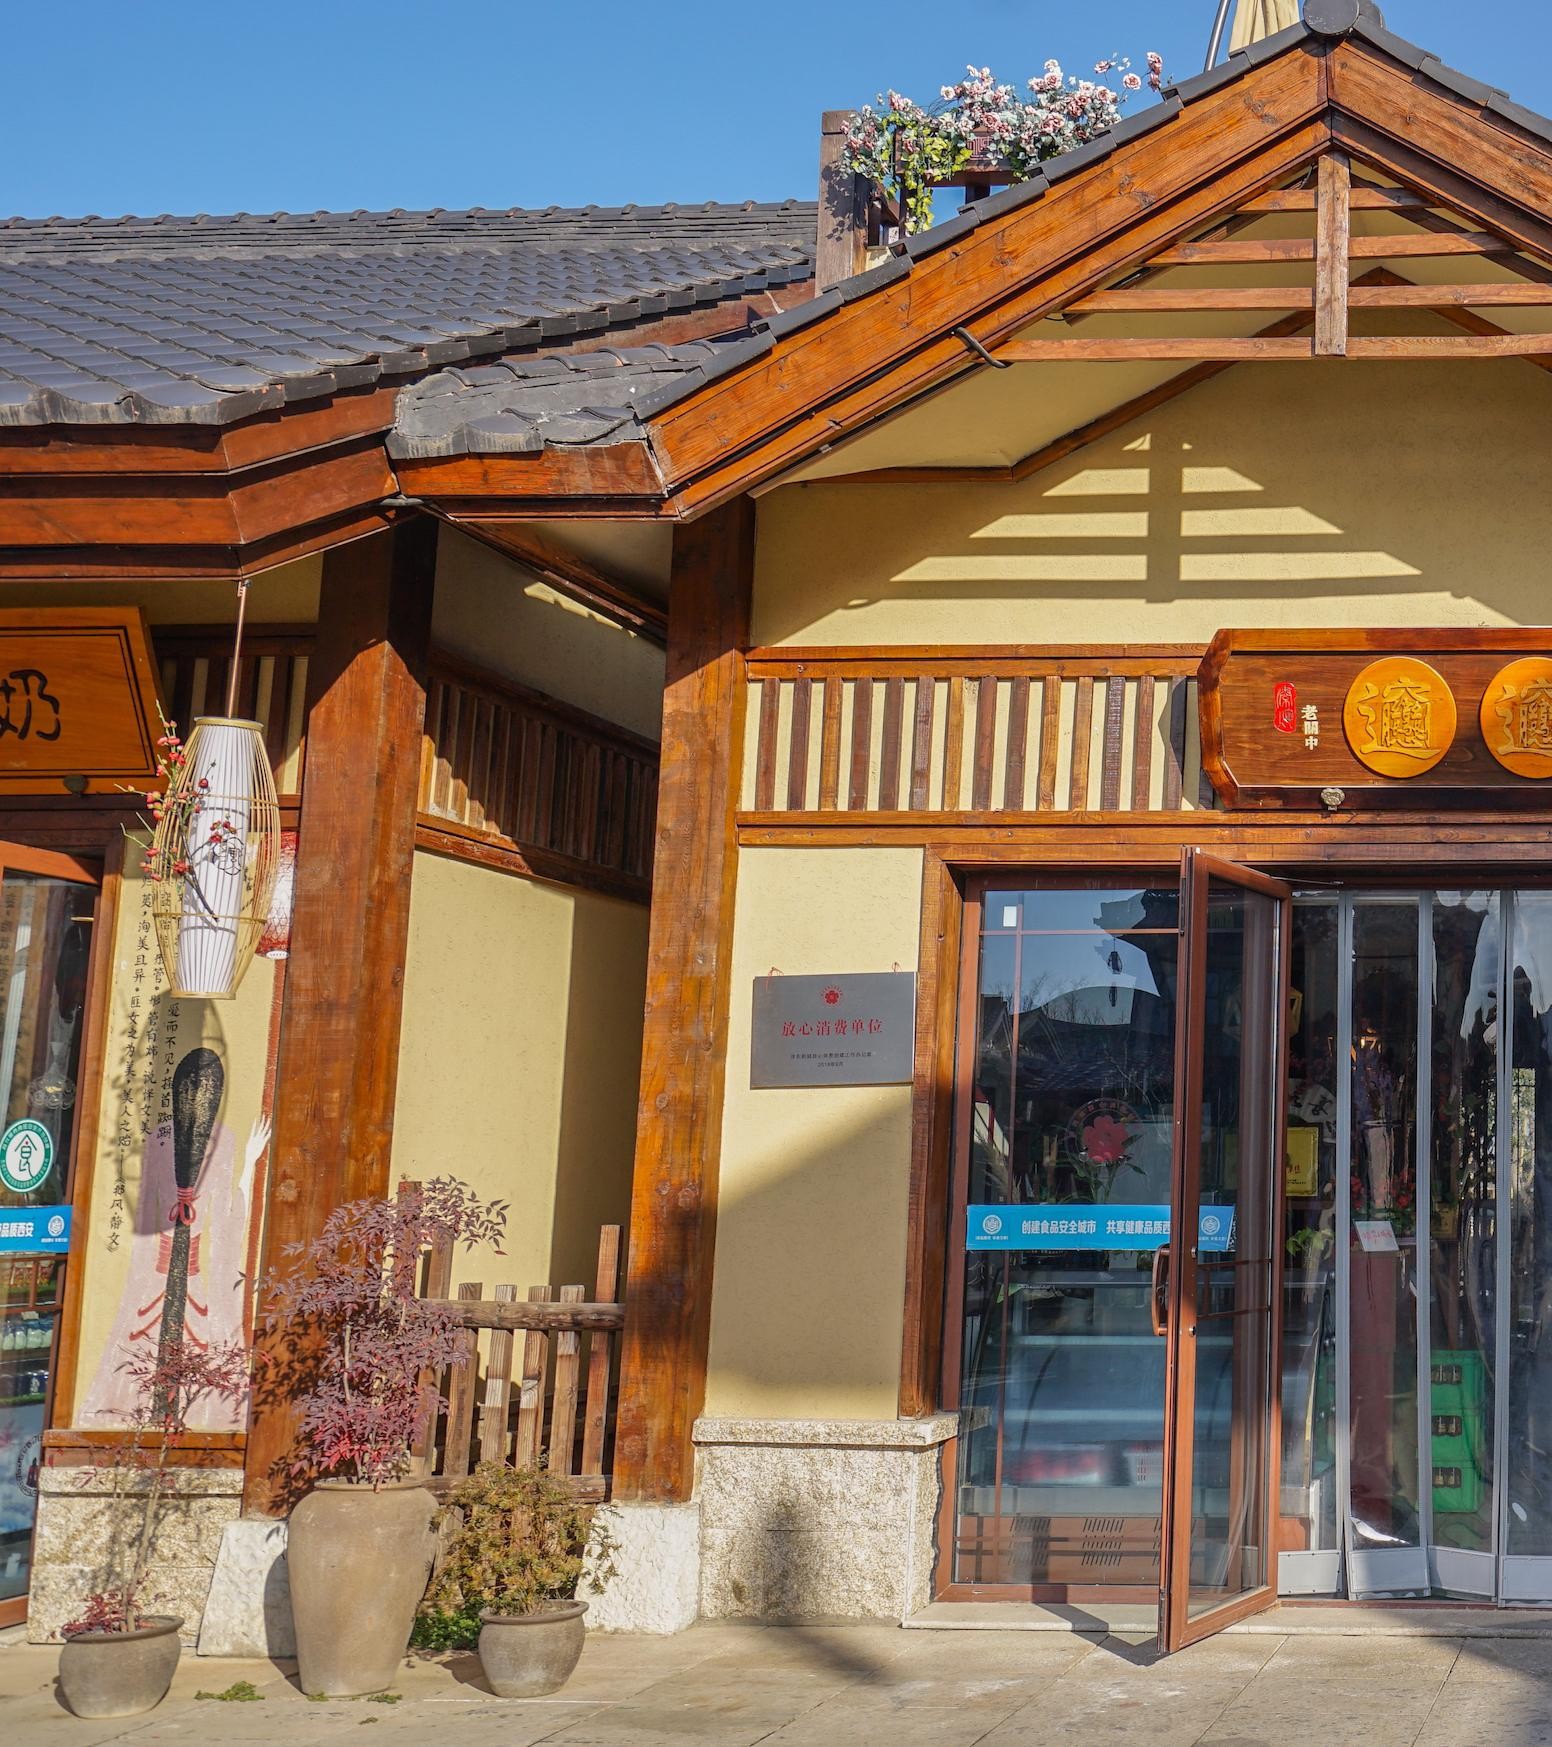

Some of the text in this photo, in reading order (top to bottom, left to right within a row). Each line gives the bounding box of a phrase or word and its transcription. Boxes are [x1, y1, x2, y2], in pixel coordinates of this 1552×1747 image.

[781, 1018, 884, 1037] 放心消费单位
[1021, 1219, 1097, 1234] 创建食品安全城市
